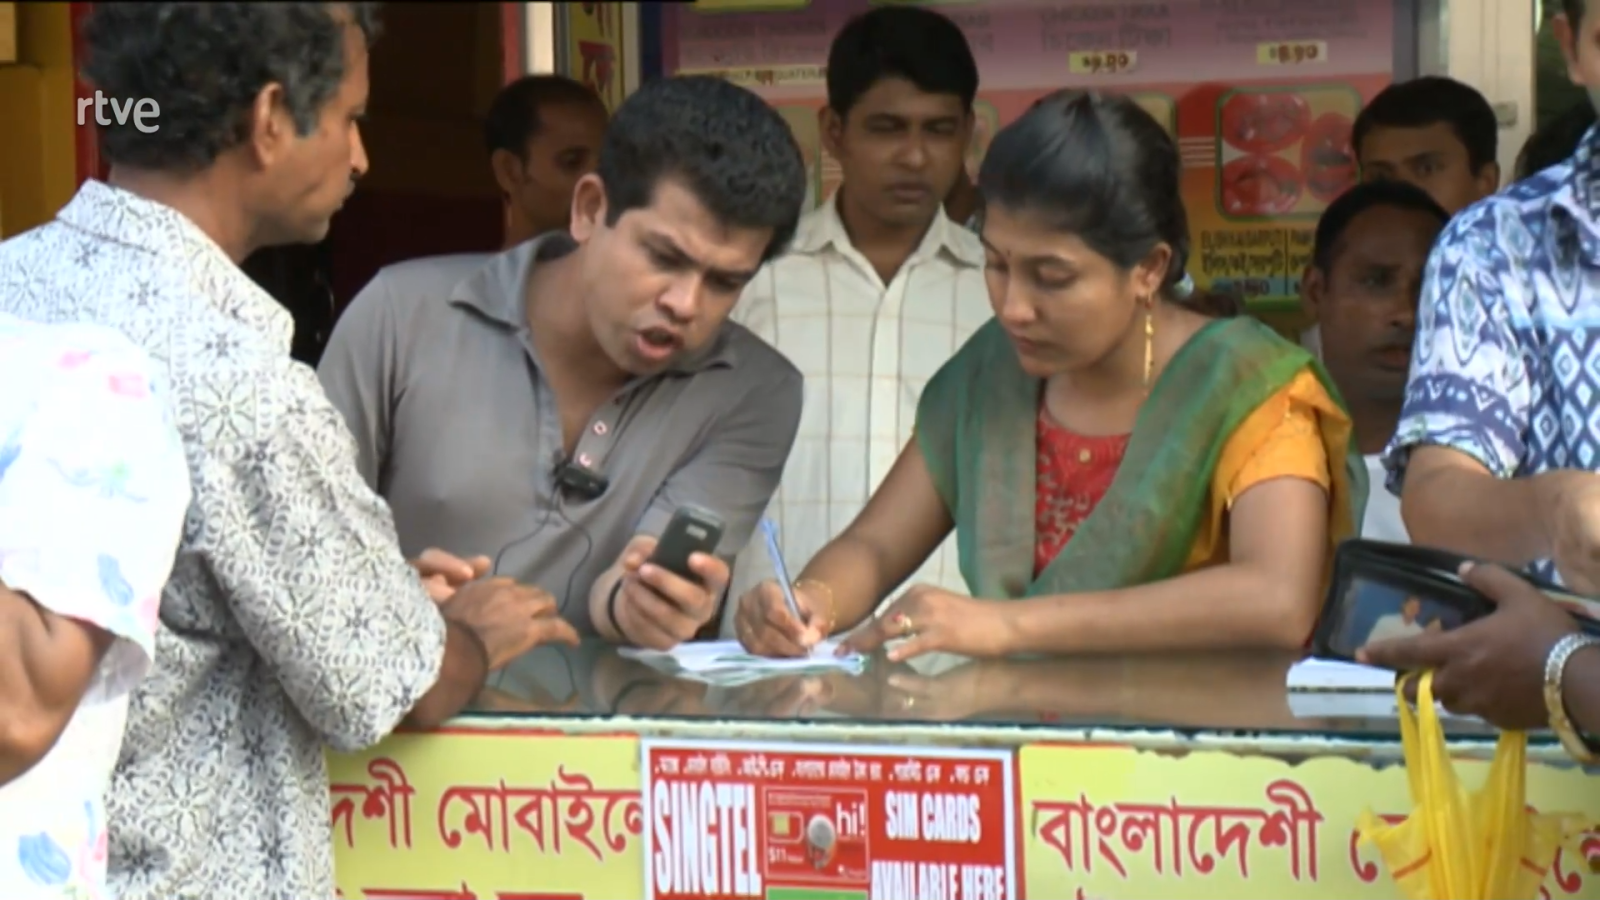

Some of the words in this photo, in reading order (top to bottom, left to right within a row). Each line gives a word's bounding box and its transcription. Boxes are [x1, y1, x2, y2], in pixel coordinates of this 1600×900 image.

[653, 779, 761, 896] SINGTEL
[836, 801, 866, 837] hi!
[885, 790, 919, 840] SIM
[921, 792, 982, 843] CARDS
[1032, 778, 1324, 883] বাংলাদেশী
